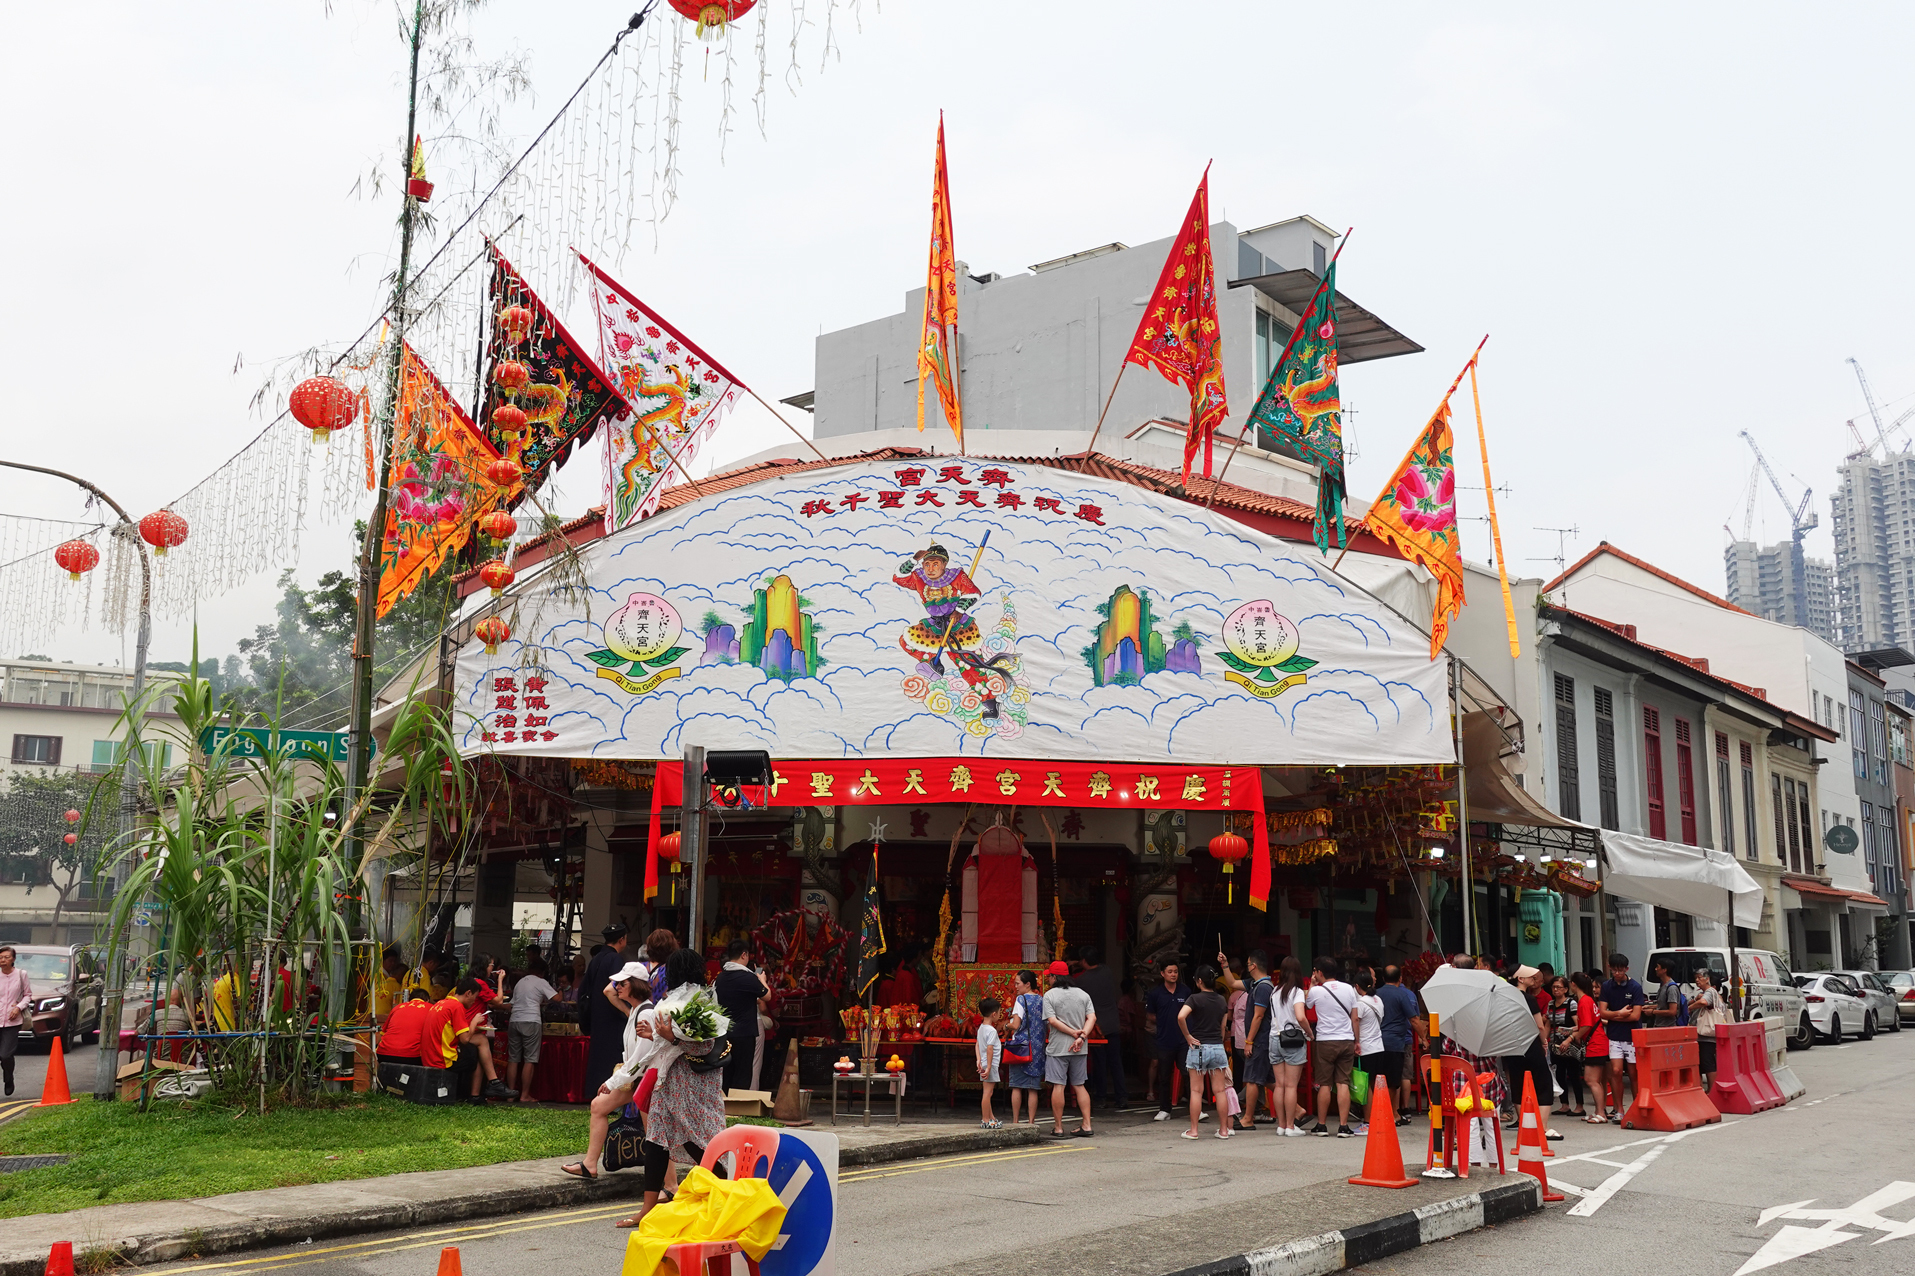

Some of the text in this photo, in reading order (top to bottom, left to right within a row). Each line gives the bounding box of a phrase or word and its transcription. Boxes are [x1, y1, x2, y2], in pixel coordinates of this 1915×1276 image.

[615, 675, 662, 691] Qi Tian Gong
[1243, 680, 1289, 696] Qi Tian Gong
